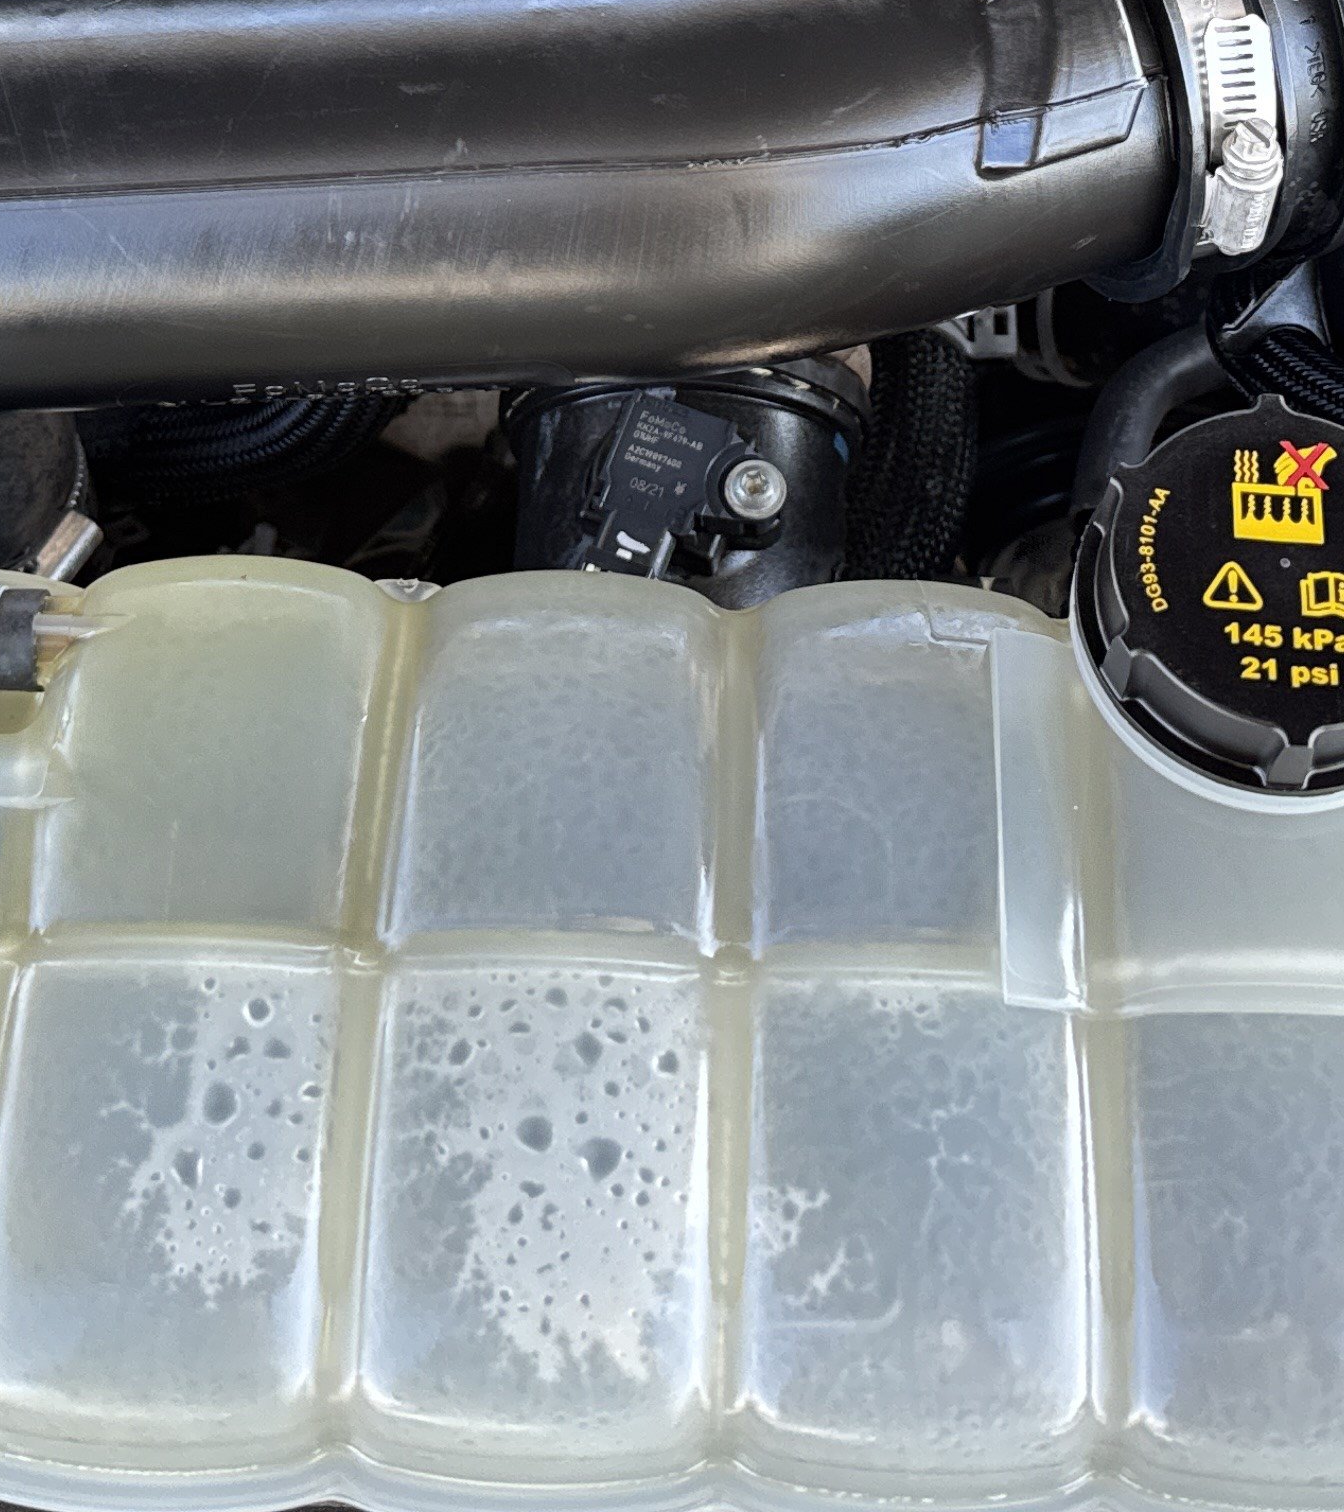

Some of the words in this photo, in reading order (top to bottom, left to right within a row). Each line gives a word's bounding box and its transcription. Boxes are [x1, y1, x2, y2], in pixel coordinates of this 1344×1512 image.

[1138, 487, 1170, 613] DG93-8101-AA
[1224, 621, 1284, 649] 145
[1239, 656, 1277, 682] 21
[1290, 662, 1339, 689] psi
